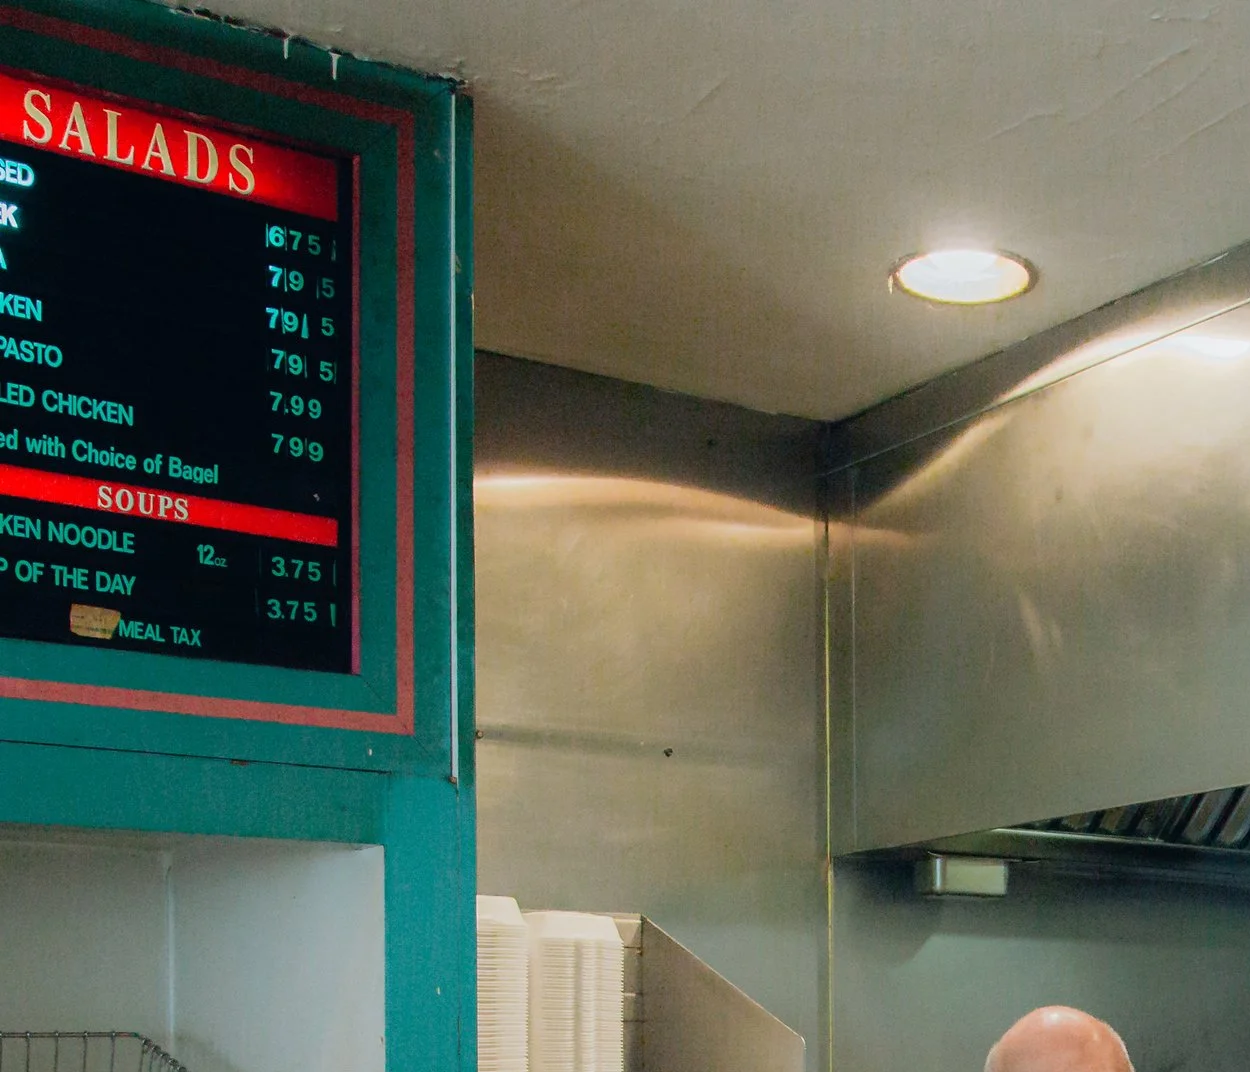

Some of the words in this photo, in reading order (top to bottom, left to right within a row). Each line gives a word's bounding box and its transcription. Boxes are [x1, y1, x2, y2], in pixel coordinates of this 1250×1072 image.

[23, 89, 256, 196] SALADS
[41, 389, 134, 427] CHICKEN
[25, 434, 66, 459] with
[71, 439, 137, 471] Choice
[143, 453, 163, 475] of
[168, 456, 219, 485] Bagel
[97, 485, 189, 521] SOUPS
[48, 520, 135, 554] NOODLE
[14, 559, 45, 584] OF
[50, 564, 89, 591] THE
[95, 570, 137, 597] DAY
[271, 556, 322, 582] 3.75
[266, 598, 318, 622] 3.75
[118, 619, 166, 643] MEAL
[169, 626, 202, 647] TAX
